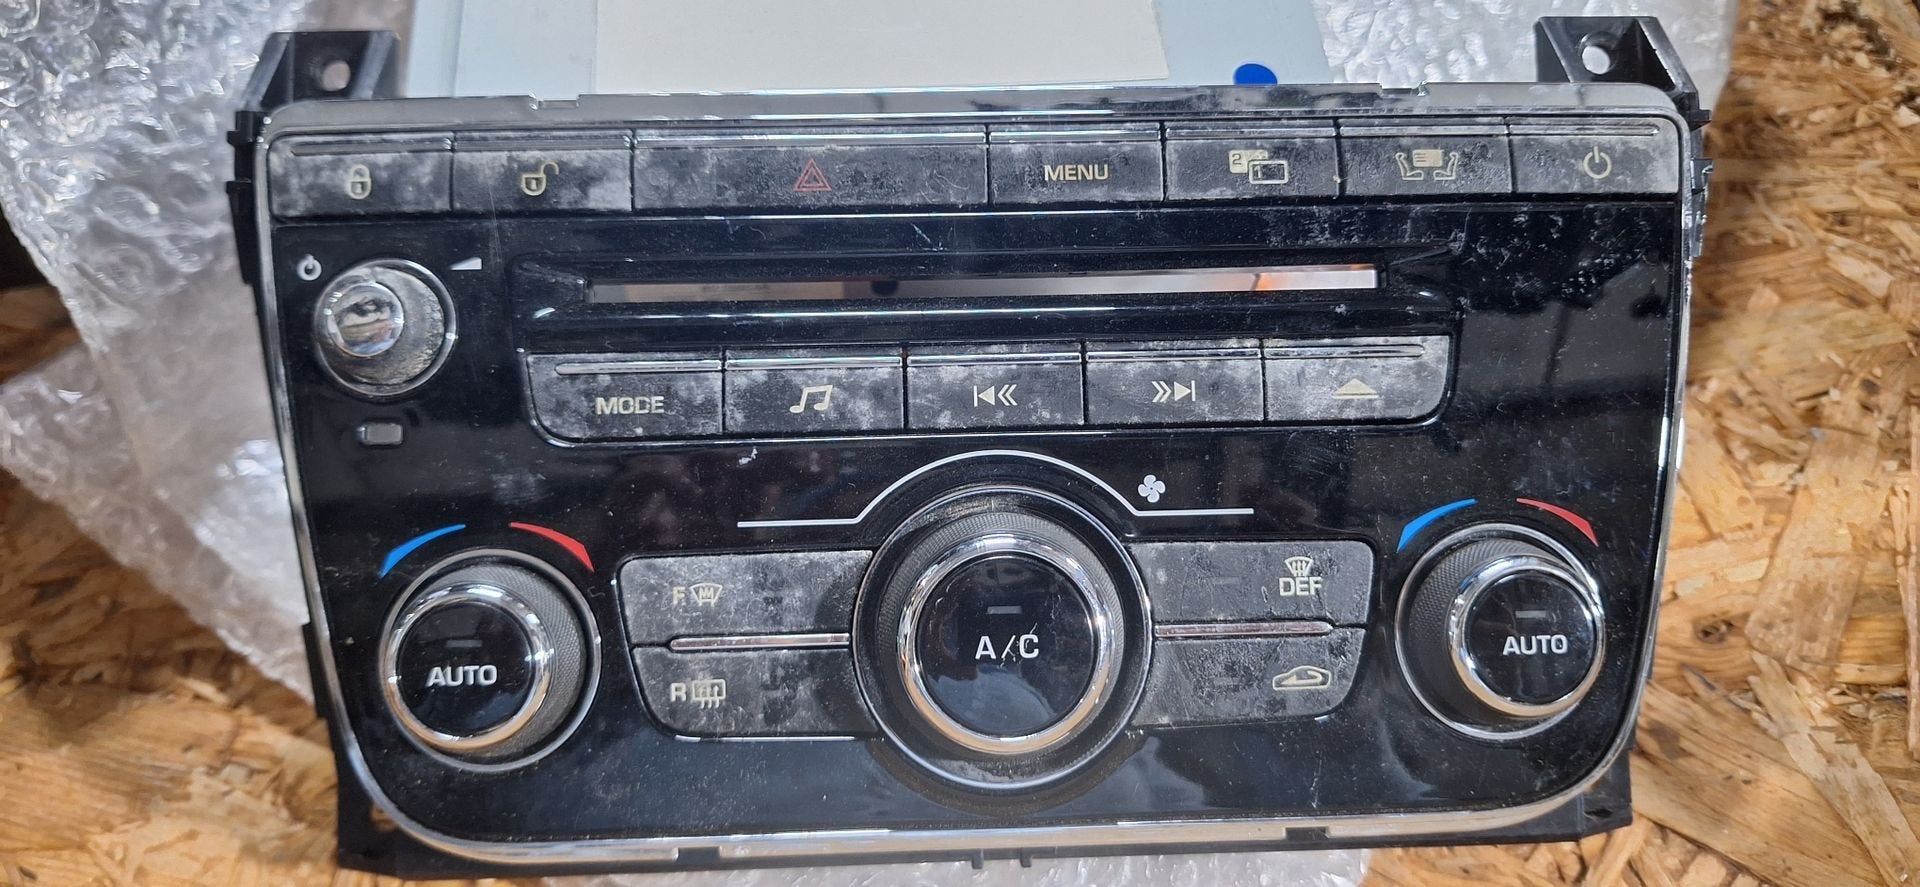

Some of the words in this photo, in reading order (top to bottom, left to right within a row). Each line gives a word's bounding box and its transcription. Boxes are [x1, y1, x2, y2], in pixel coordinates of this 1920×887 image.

[1232, 153, 1242, 166] 2
[1044, 163, 1109, 181] MENU
[595, 395, 665, 415] MODE
[672, 586, 686, 606] F
[1279, 576, 1323, 596] DEF
[975, 633, 1039, 660] A/C
[1502, 633, 1568, 656] AUTO
[425, 664, 498, 687] AUTO
[670, 682, 687, 702] R
